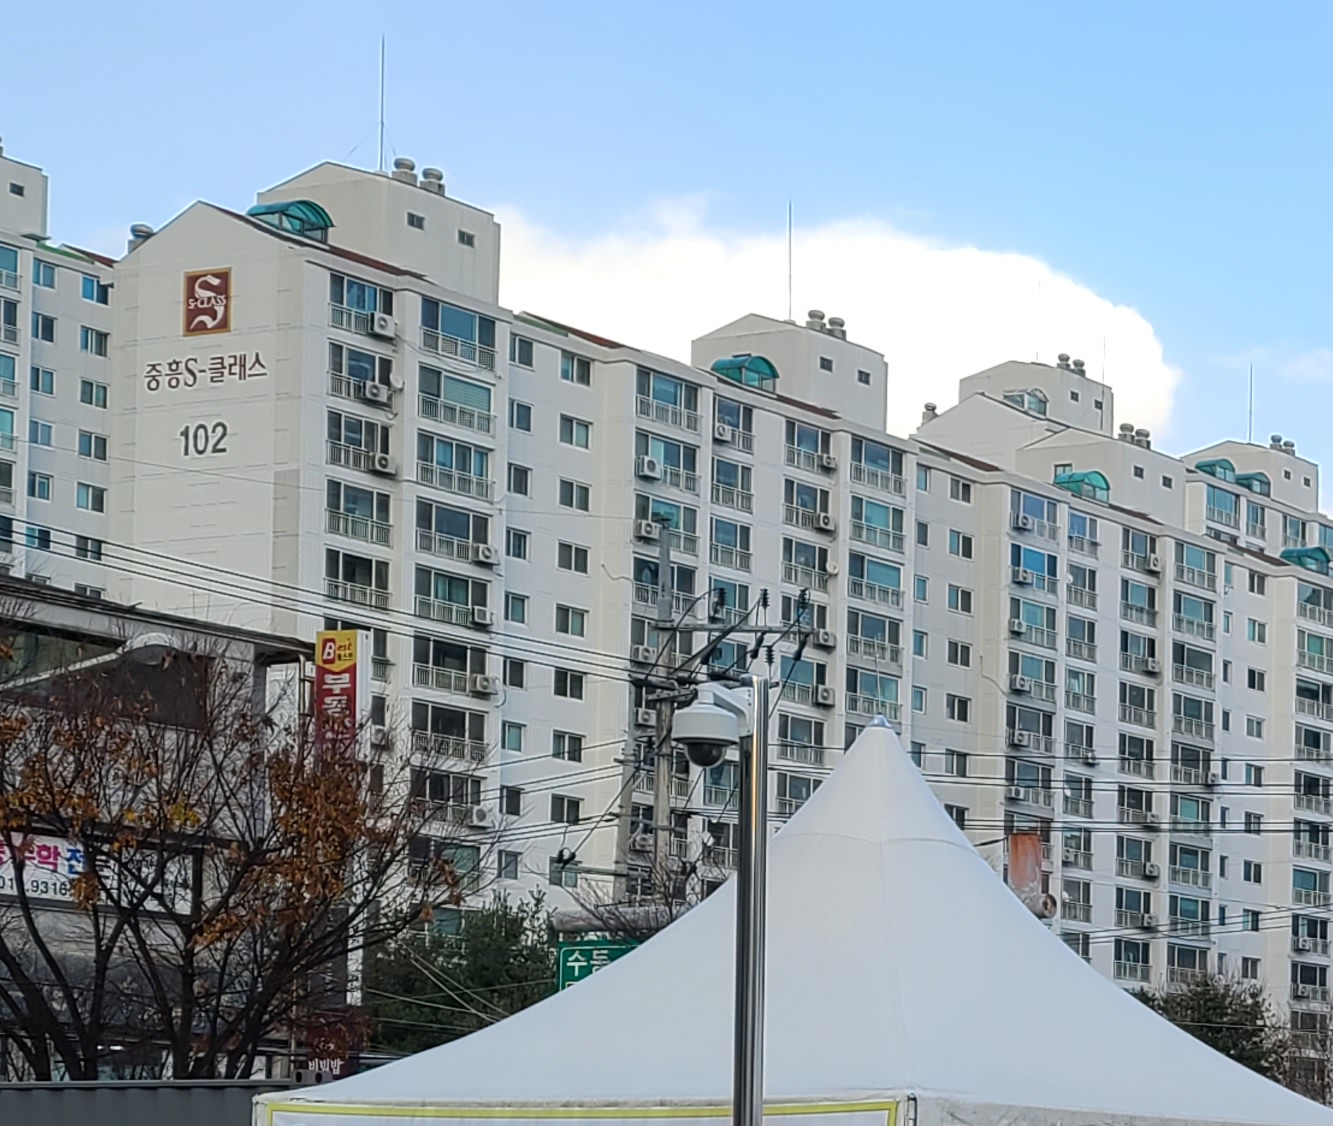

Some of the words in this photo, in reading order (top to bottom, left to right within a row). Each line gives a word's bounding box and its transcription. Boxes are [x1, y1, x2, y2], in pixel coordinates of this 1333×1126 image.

[188, 294, 227, 309] S-CLASS
[143, 352, 268, 392] 중흥S-클래스
[180, 421, 228, 457] 102
